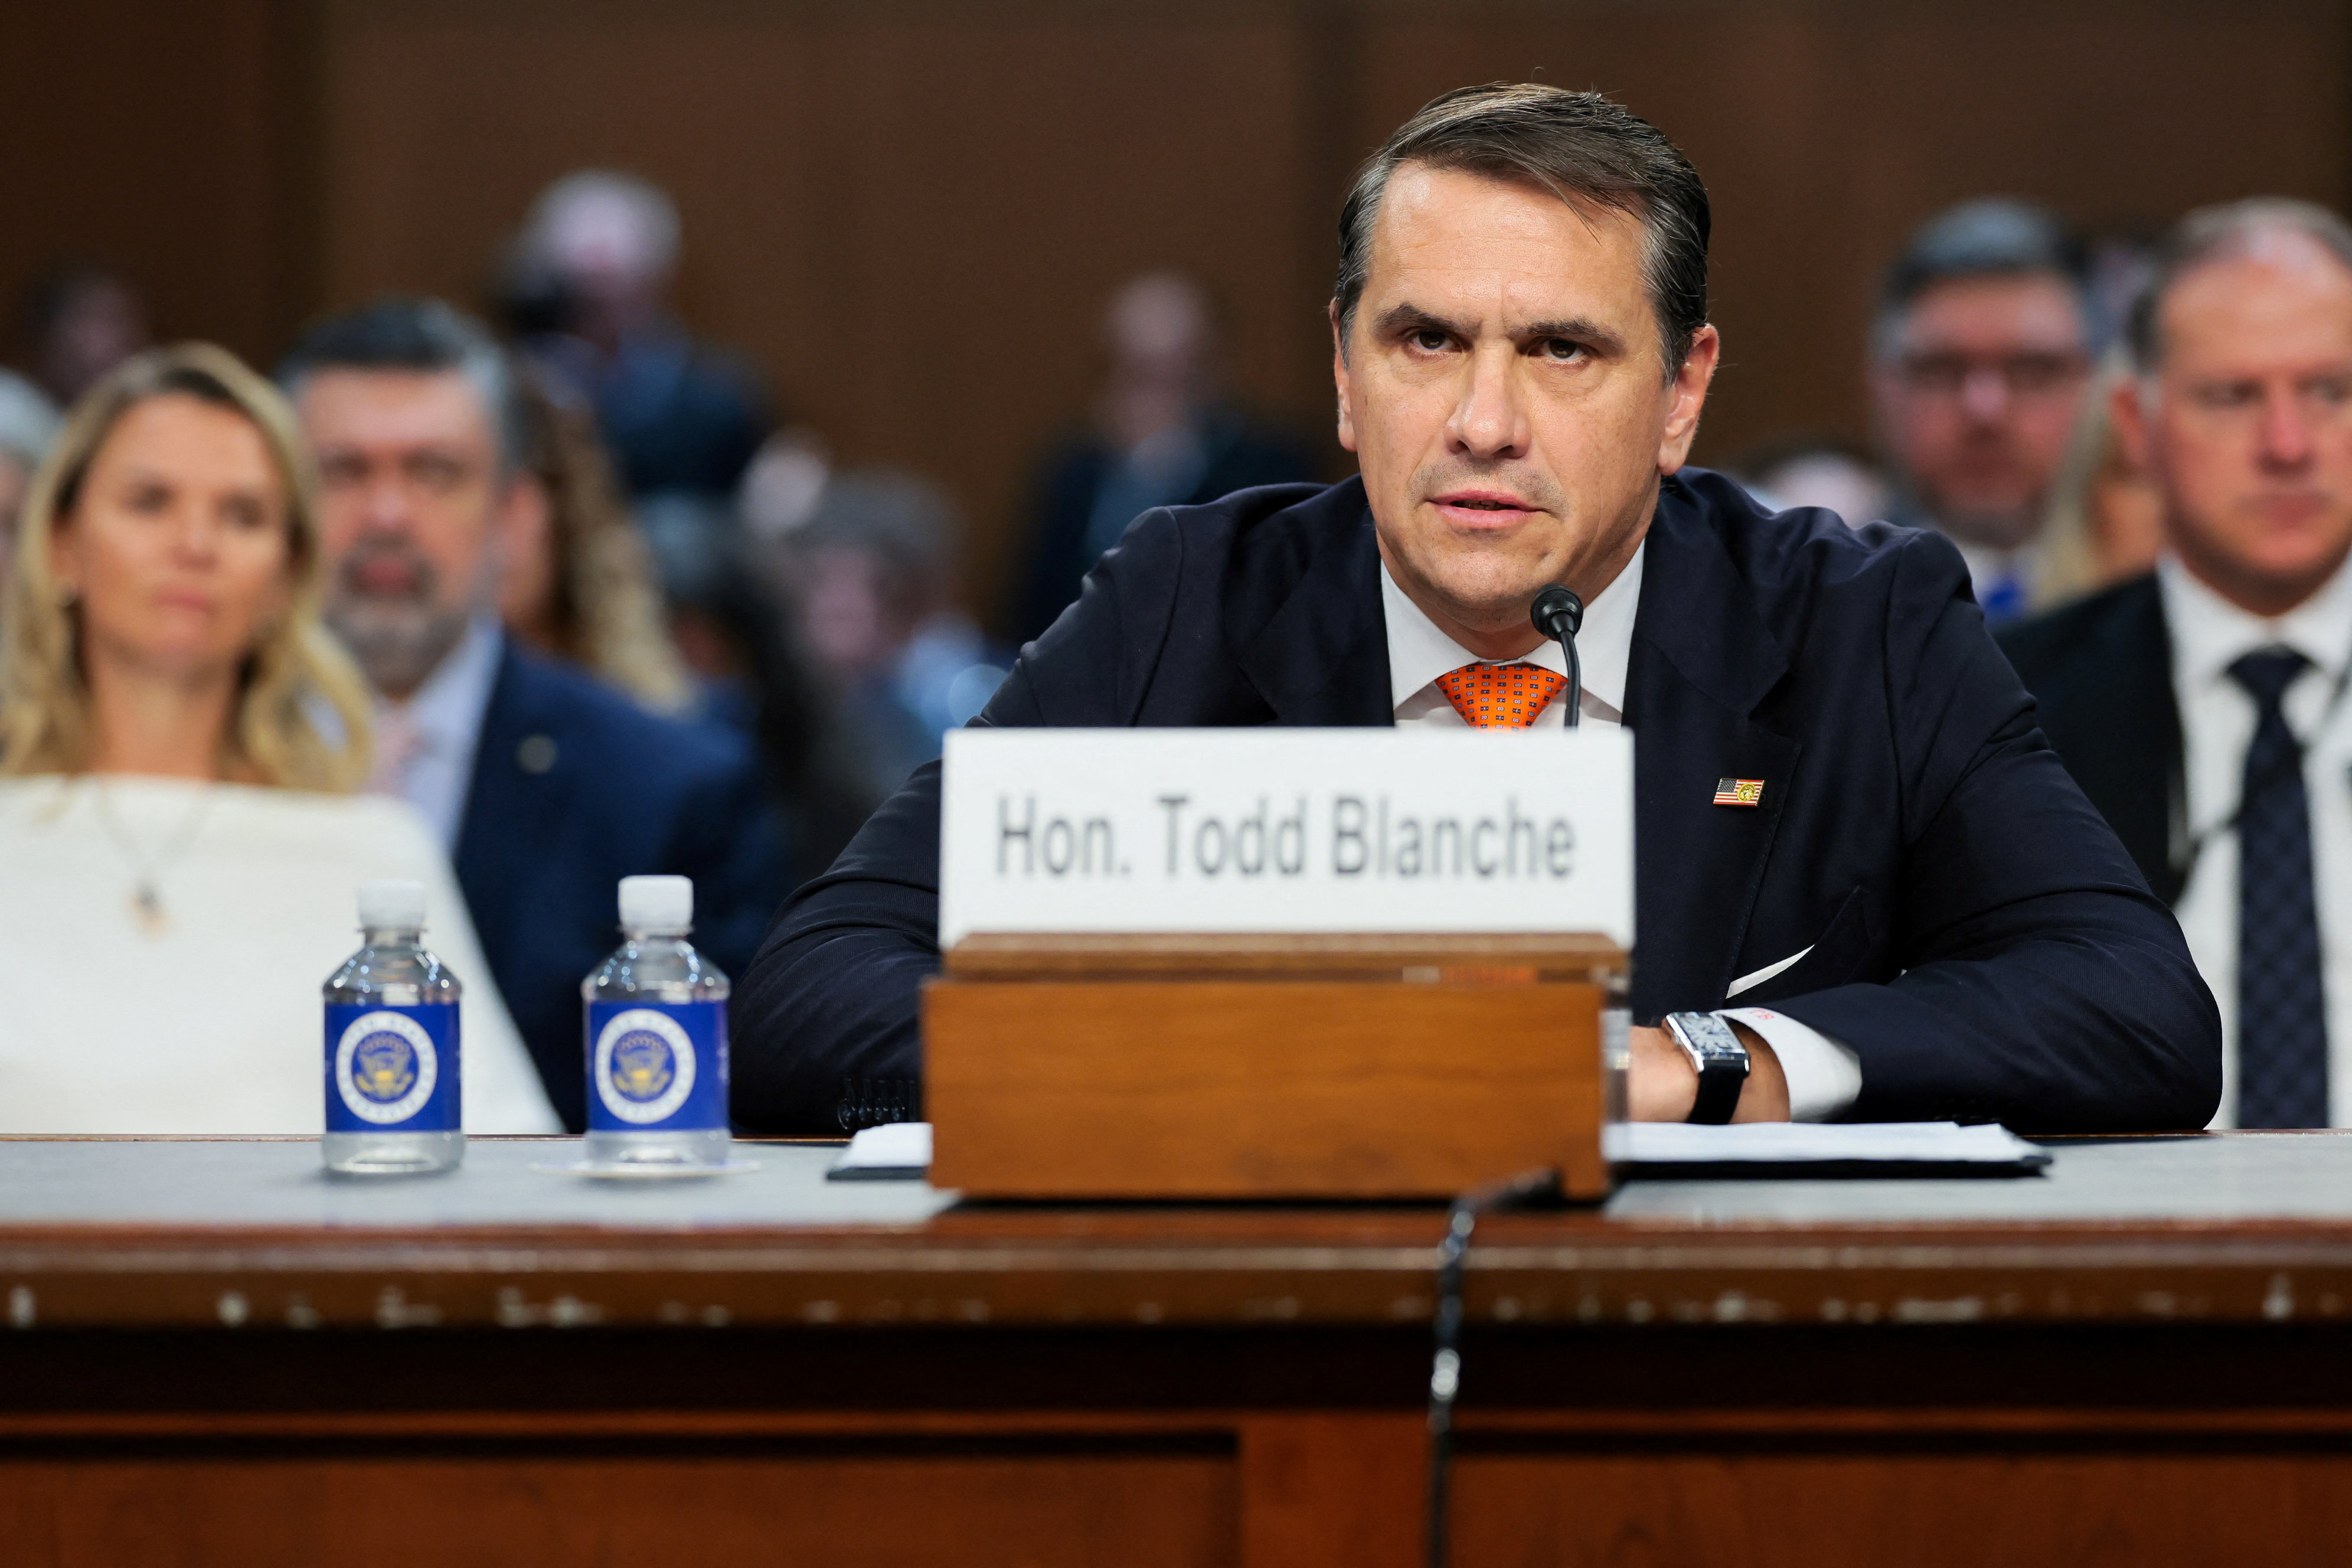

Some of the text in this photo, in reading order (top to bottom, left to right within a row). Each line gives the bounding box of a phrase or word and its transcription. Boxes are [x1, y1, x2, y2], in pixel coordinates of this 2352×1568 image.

[997, 794, 1575, 878] Hon. Todd Blanche
